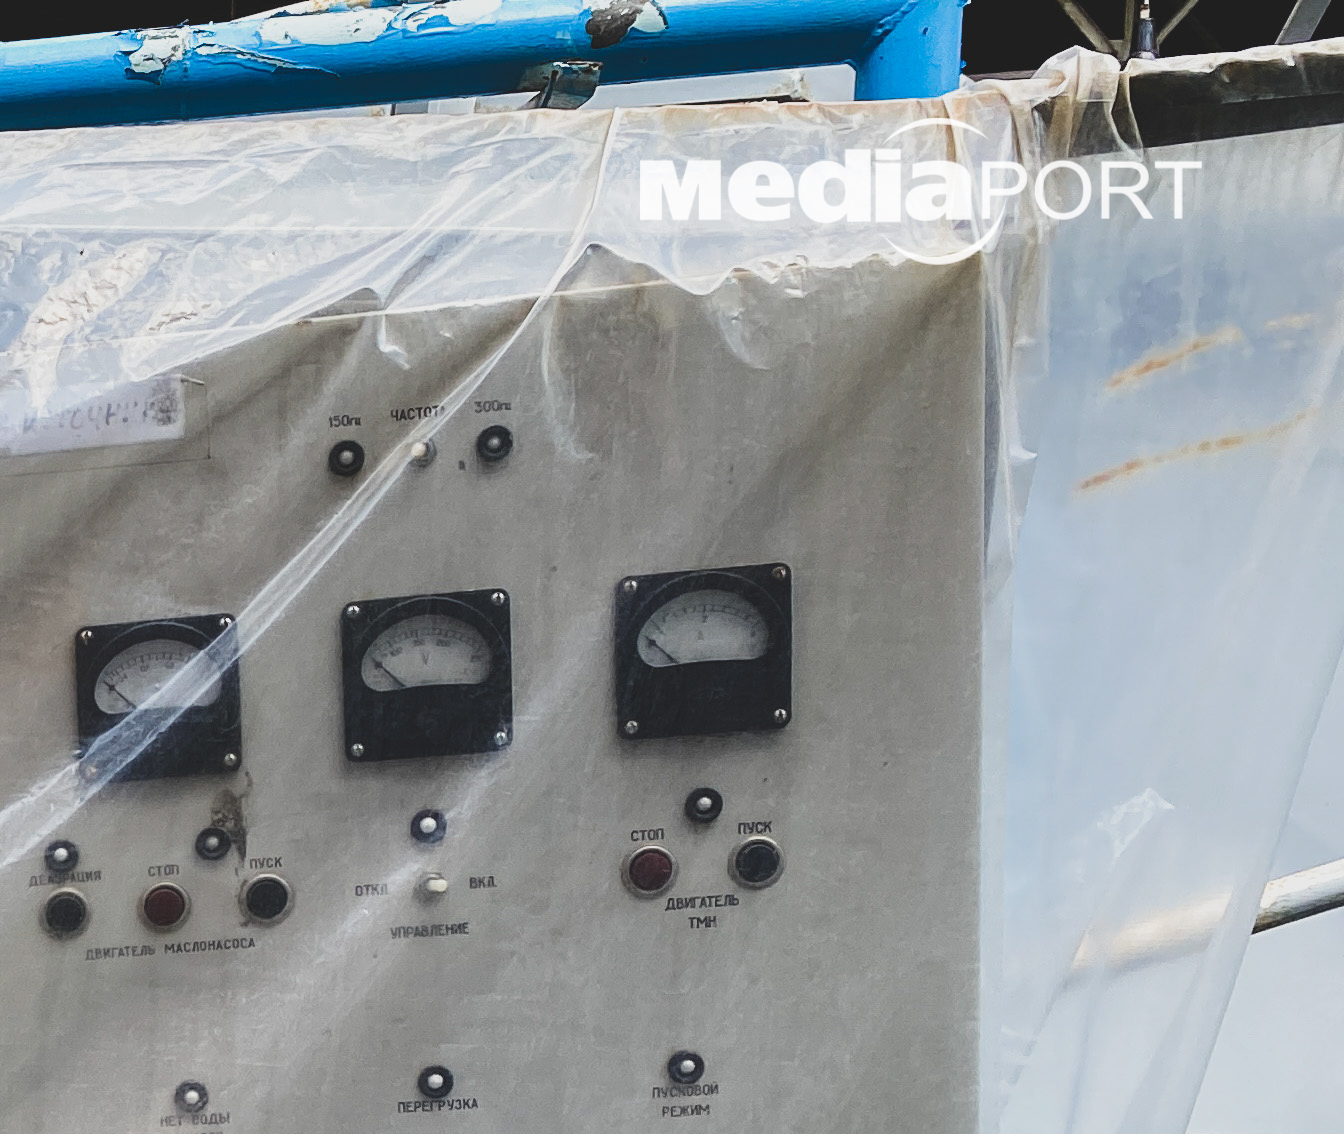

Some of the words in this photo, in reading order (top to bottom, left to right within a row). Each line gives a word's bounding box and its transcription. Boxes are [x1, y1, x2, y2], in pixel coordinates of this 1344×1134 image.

[630, 828, 665, 842] СТОП
[737, 821, 772, 835] ПУСК
[148, 864, 180, 877] СТОП
[249, 857, 283, 870] ПУСК
[665, 894, 740, 911] ДВИГАТЕЛЬ
[688, 916, 717, 929] ТМН
[390, 921, 470, 939] УПРАВЛЕНИЕ
[85, 945, 156, 961] ДВИГАТЕЛЬ
[164, 937, 256, 955] МАСЛОНАСОСА
[397, 1098, 479, 1113] ПЕРЕГРУЗКА
[662, 1104, 710, 1117] РЕЖИМ
